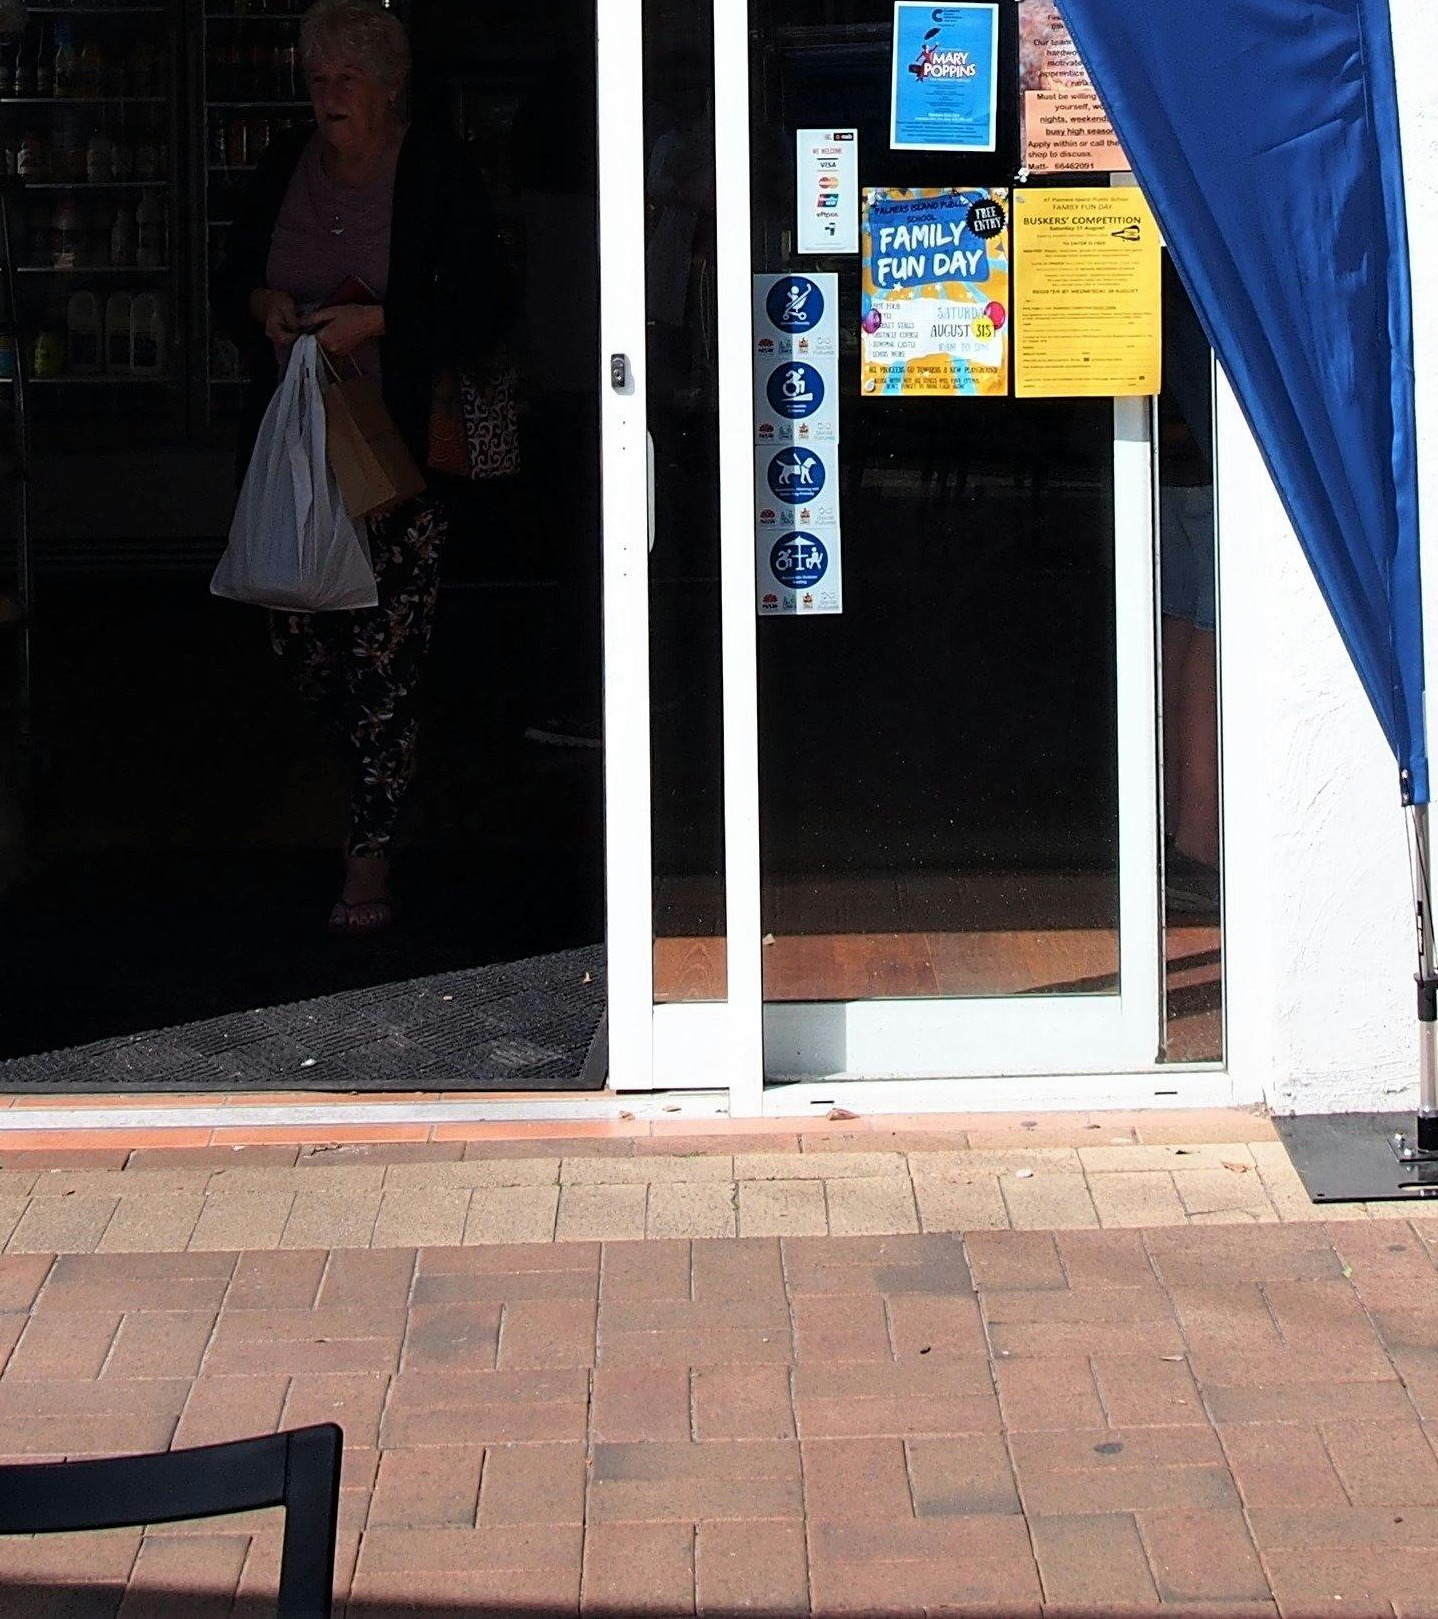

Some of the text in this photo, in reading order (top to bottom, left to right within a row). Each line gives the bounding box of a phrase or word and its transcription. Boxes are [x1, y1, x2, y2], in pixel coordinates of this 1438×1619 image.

[932, 51, 969, 65] MARY
[923, 62, 976, 78] POPPINS
[1070, 93, 1097, 101] willing
[1054, 103, 1091, 112] yourself,
[1045, 128, 1065, 136] busy
[1066, 128, 1085, 136] high
[1028, 141, 1051, 149] Apply
[1028, 151, 1048, 159] shop
[974, 206, 998, 220] FREE
[1071, 216, 1141, 224] COMPETITION
[973, 216, 1002, 232] ENTRY
[879, 221, 967, 254] FAMILY
[877, 249, 983, 284] FUN DAY
[937, 306, 984, 320] SATURDA
[930, 323, 970, 338] AUGUST
